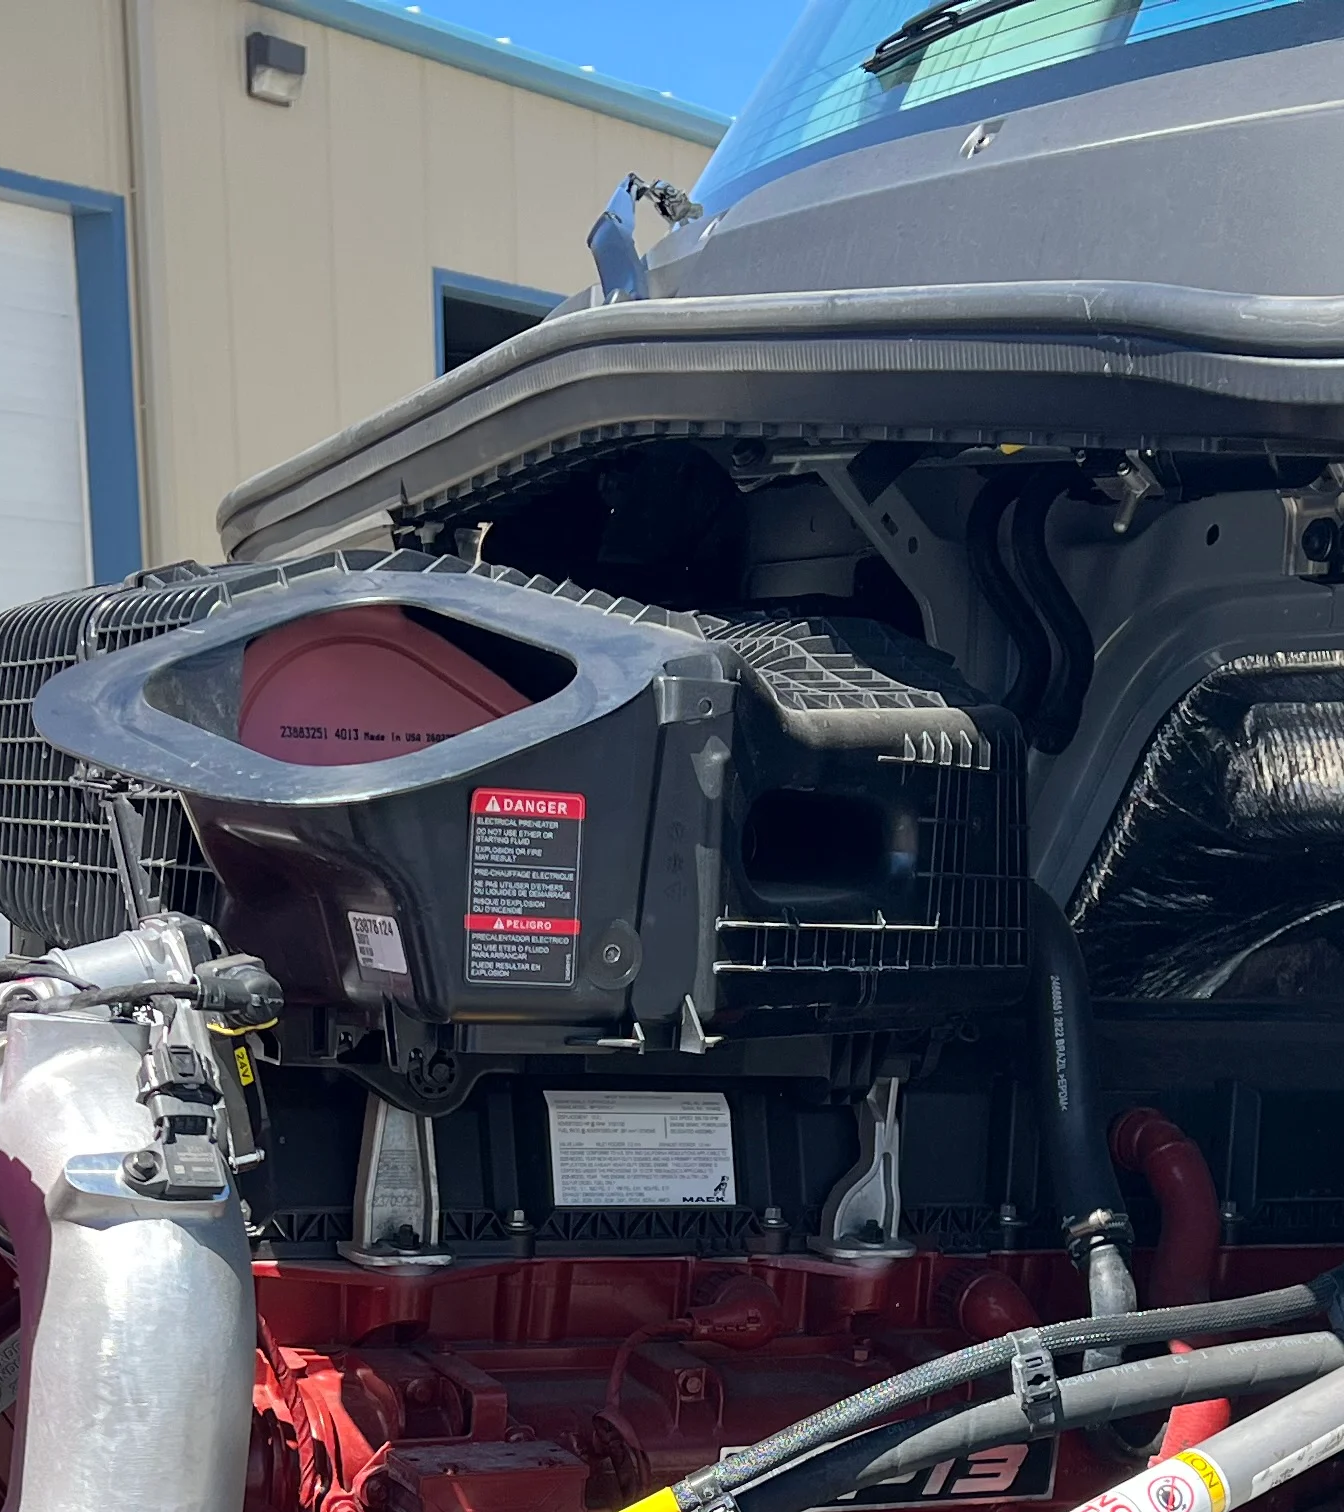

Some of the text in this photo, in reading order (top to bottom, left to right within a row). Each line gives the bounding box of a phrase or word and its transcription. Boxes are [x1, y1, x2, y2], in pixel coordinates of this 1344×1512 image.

[280, 726, 328, 740] 23883251
[334, 727, 359, 740] 4013
[503, 798, 568, 815] DANGER
[476, 817, 558, 829] ELECTRICAL PREHEATER
[504, 829, 517, 837] USE
[519, 830, 541, 839] ETHER
[543, 831, 554, 839] OR
[476, 836, 530, 845] STARTING FLUID
[476, 845, 514, 854] EXPLOSION
[527, 849, 542, 857] FIRE
[500, 882, 529, 890] UTILISER
[473, 898, 499, 906] RISQUE
[506, 920, 552, 930] PELIGRO
[471, 961, 494, 969] PUEDE
[495, 962, 529, 971] RESULTAR
[1056, 1039, 1066, 1073] BRAZIL
[236, 1052, 251, 1080] 24V
